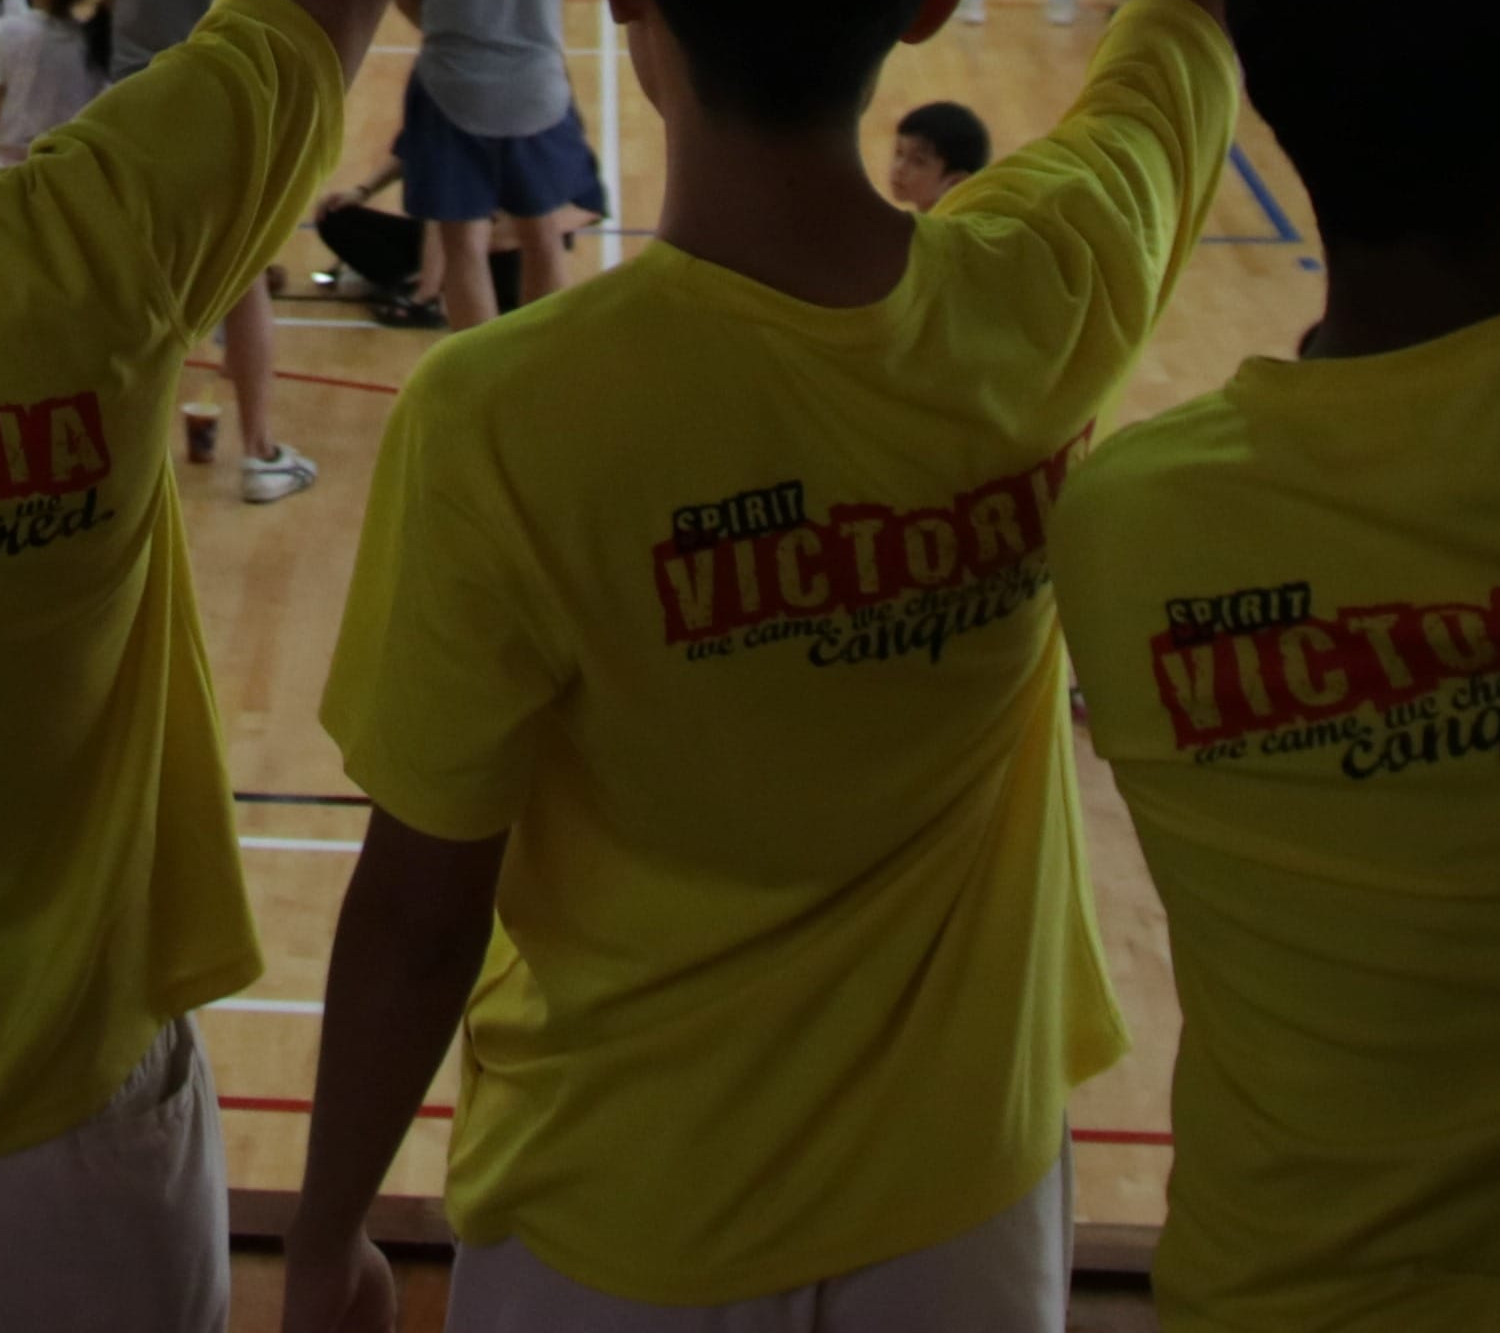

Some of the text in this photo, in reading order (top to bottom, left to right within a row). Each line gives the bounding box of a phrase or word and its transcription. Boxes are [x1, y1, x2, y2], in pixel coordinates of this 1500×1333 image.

[14, 496, 64, 517] we
[676, 483, 802, 540] SPIRIT
[1167, 586, 1308, 642] SPIRIT
[685, 634, 734, 662] we
[1384, 696, 1440, 731] we
